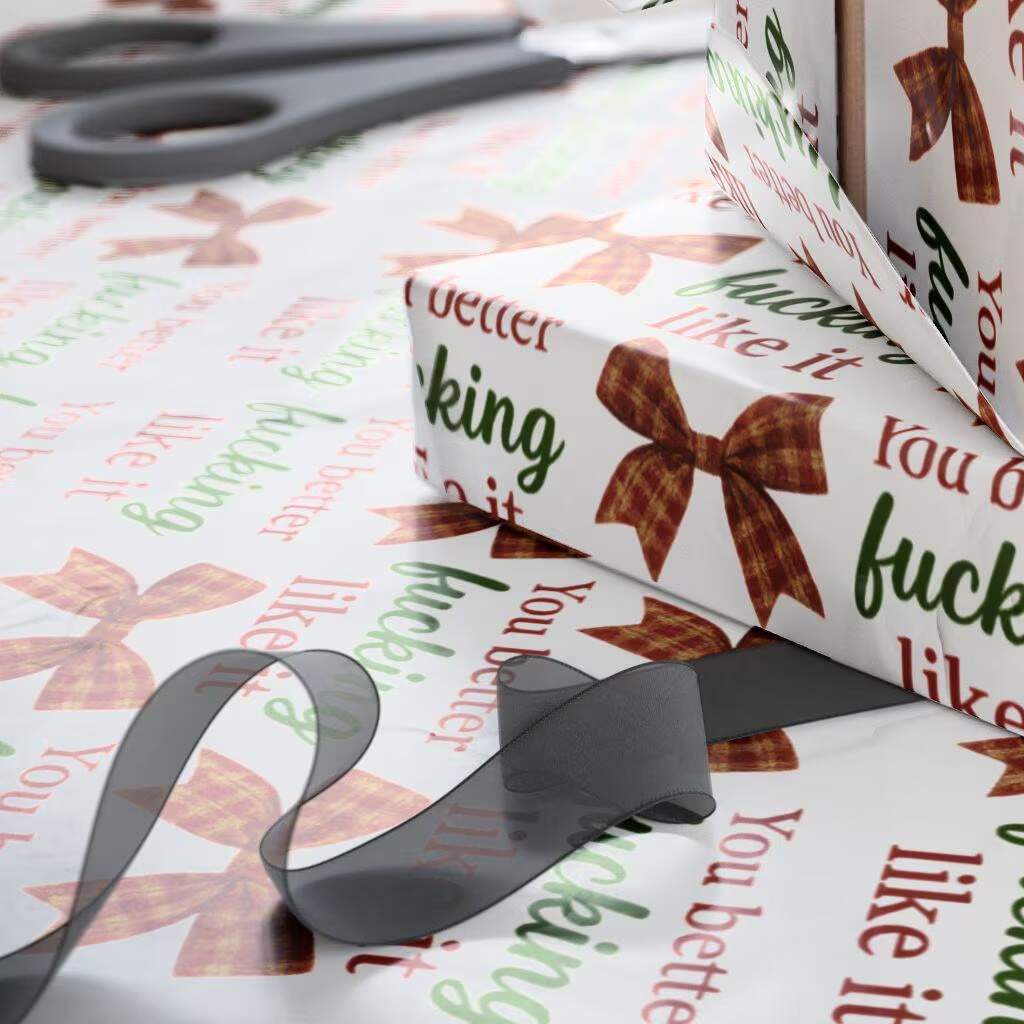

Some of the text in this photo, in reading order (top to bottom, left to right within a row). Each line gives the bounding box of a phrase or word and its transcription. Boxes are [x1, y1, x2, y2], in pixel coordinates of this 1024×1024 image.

[648, 306, 864, 381] like it
[977, 270, 1003, 396] You
[21, 400, 117, 441] You
[64, 412, 227, 503] like it
[416, 343, 567, 495] king
[873, 415, 978, 496] You
[121, 401, 348, 536] fucking
[257, 464, 376, 543] better
[194, 574, 371, 699] like it
[425, 579, 597, 754] You better
[0, 741, 118, 816] You
[701, 808, 804, 889] You
[857, 844, 984, 960] like
